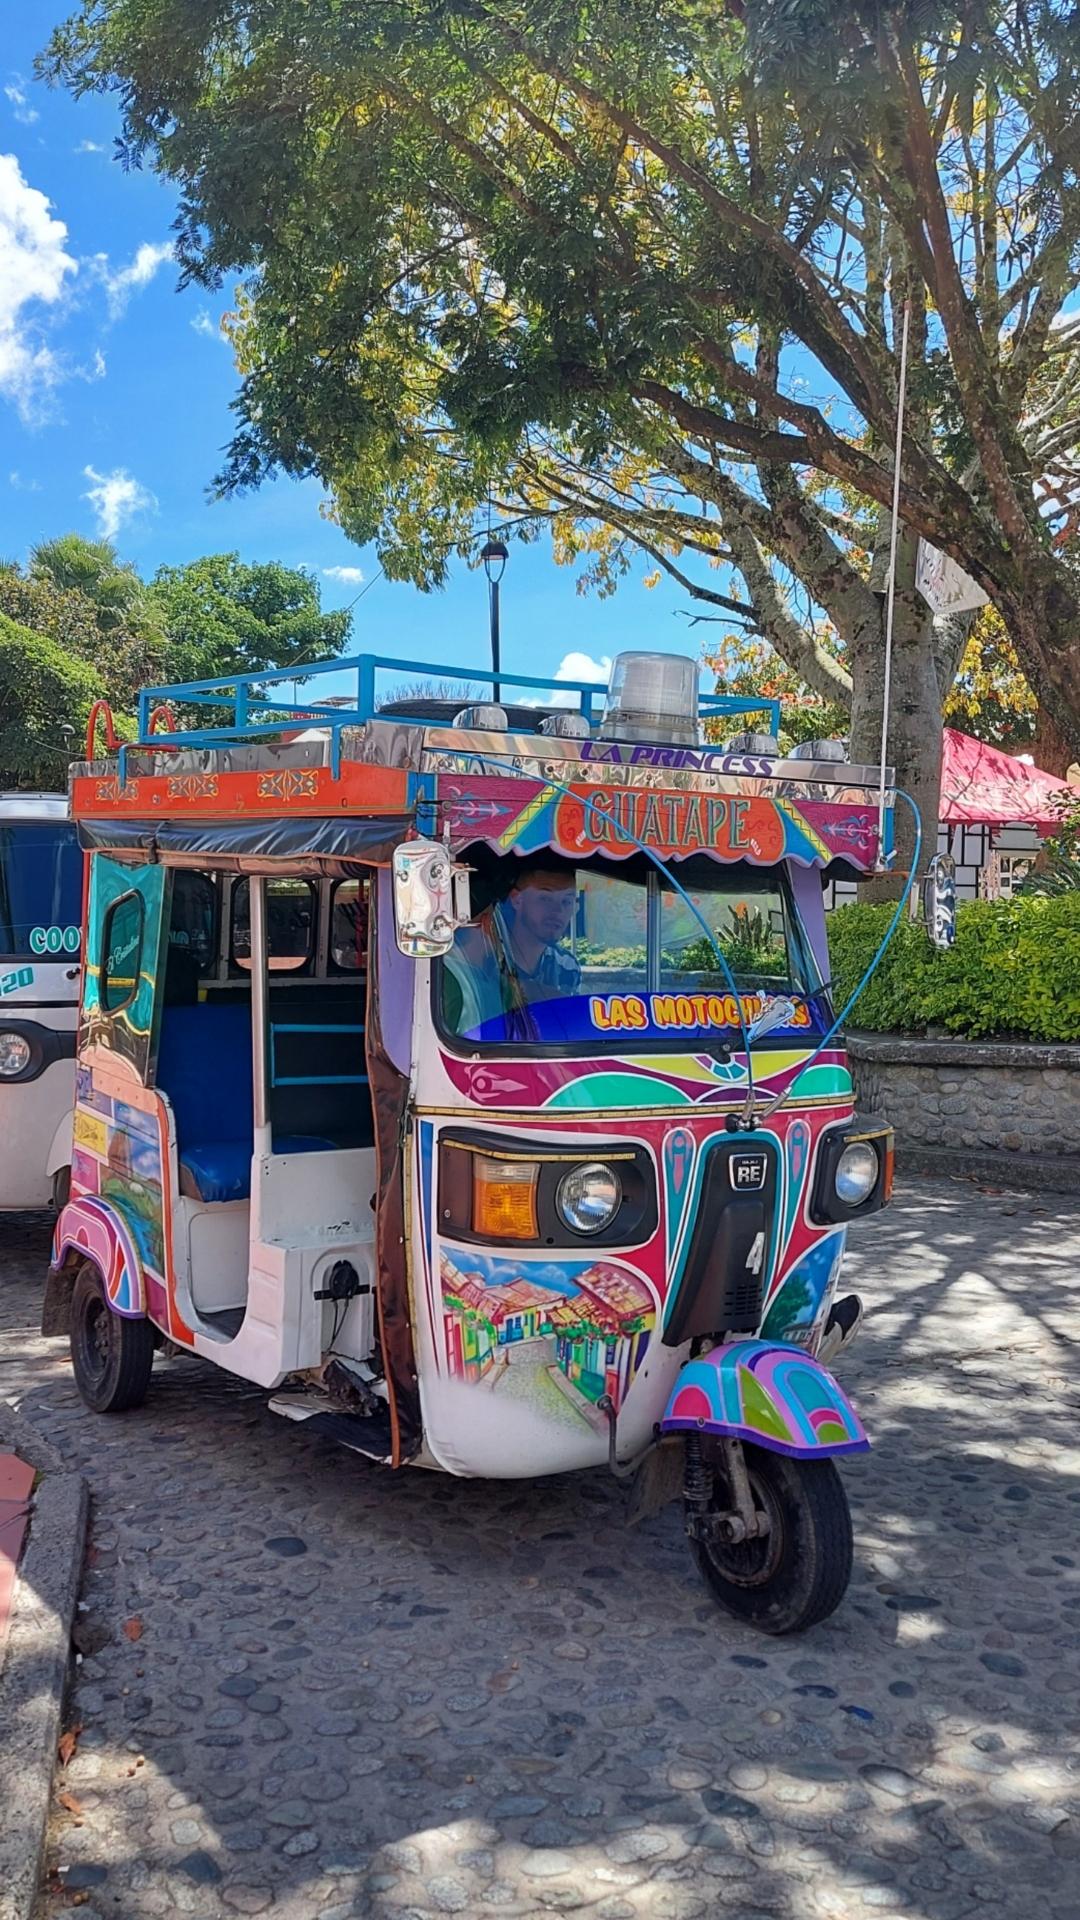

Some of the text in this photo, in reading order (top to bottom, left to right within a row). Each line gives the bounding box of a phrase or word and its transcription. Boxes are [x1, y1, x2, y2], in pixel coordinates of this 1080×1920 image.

[580, 740, 777, 777] LA PRINCESS
[584, 790, 752, 849] GUATAPE
[29, 925, 84, 954] COO
[0, 965, 35, 997] 20
[590, 996, 648, 1030] LAS
[737, 1165, 761, 1183] RE
